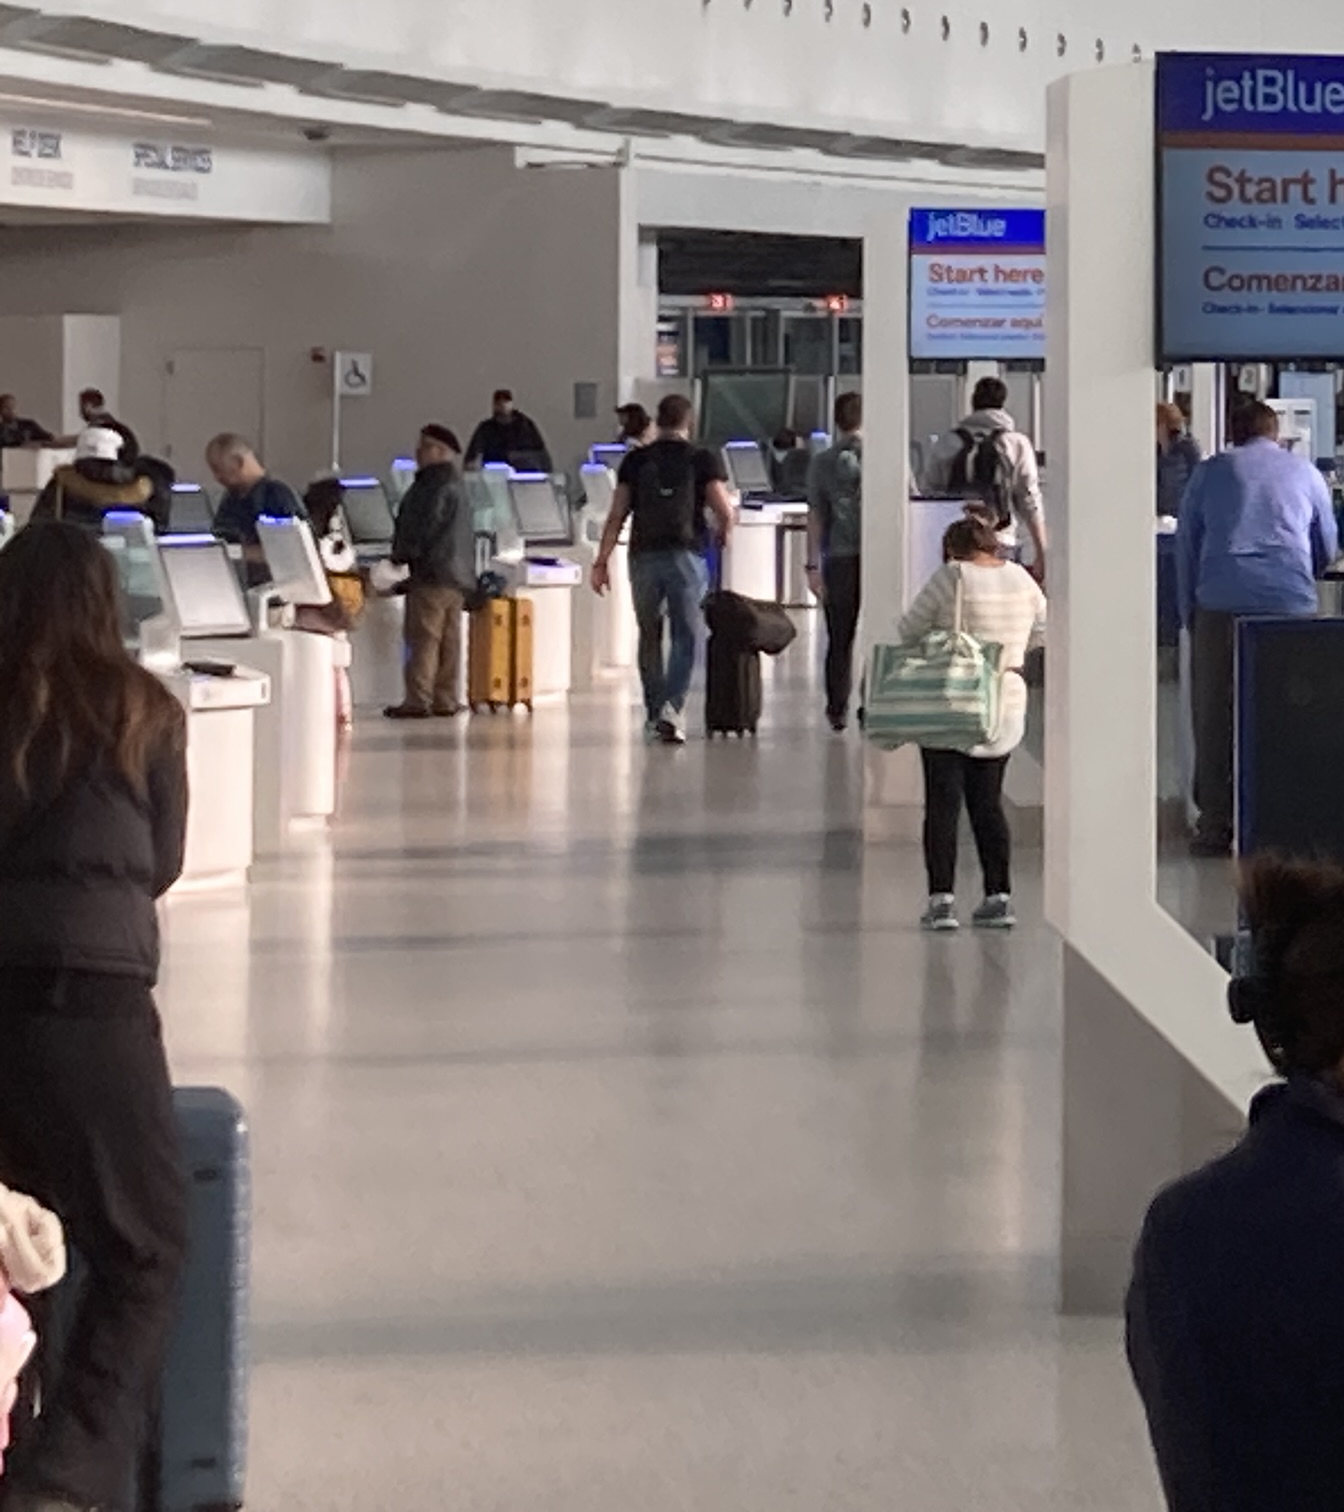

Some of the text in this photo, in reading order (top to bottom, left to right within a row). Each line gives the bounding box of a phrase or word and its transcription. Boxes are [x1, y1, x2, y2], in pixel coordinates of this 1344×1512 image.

[1205, 163, 1317, 205] Start
[926, 211, 1007, 242] jetBlue
[1203, 212, 1283, 230] Check-in
[928, 263, 1045, 284] Start here
